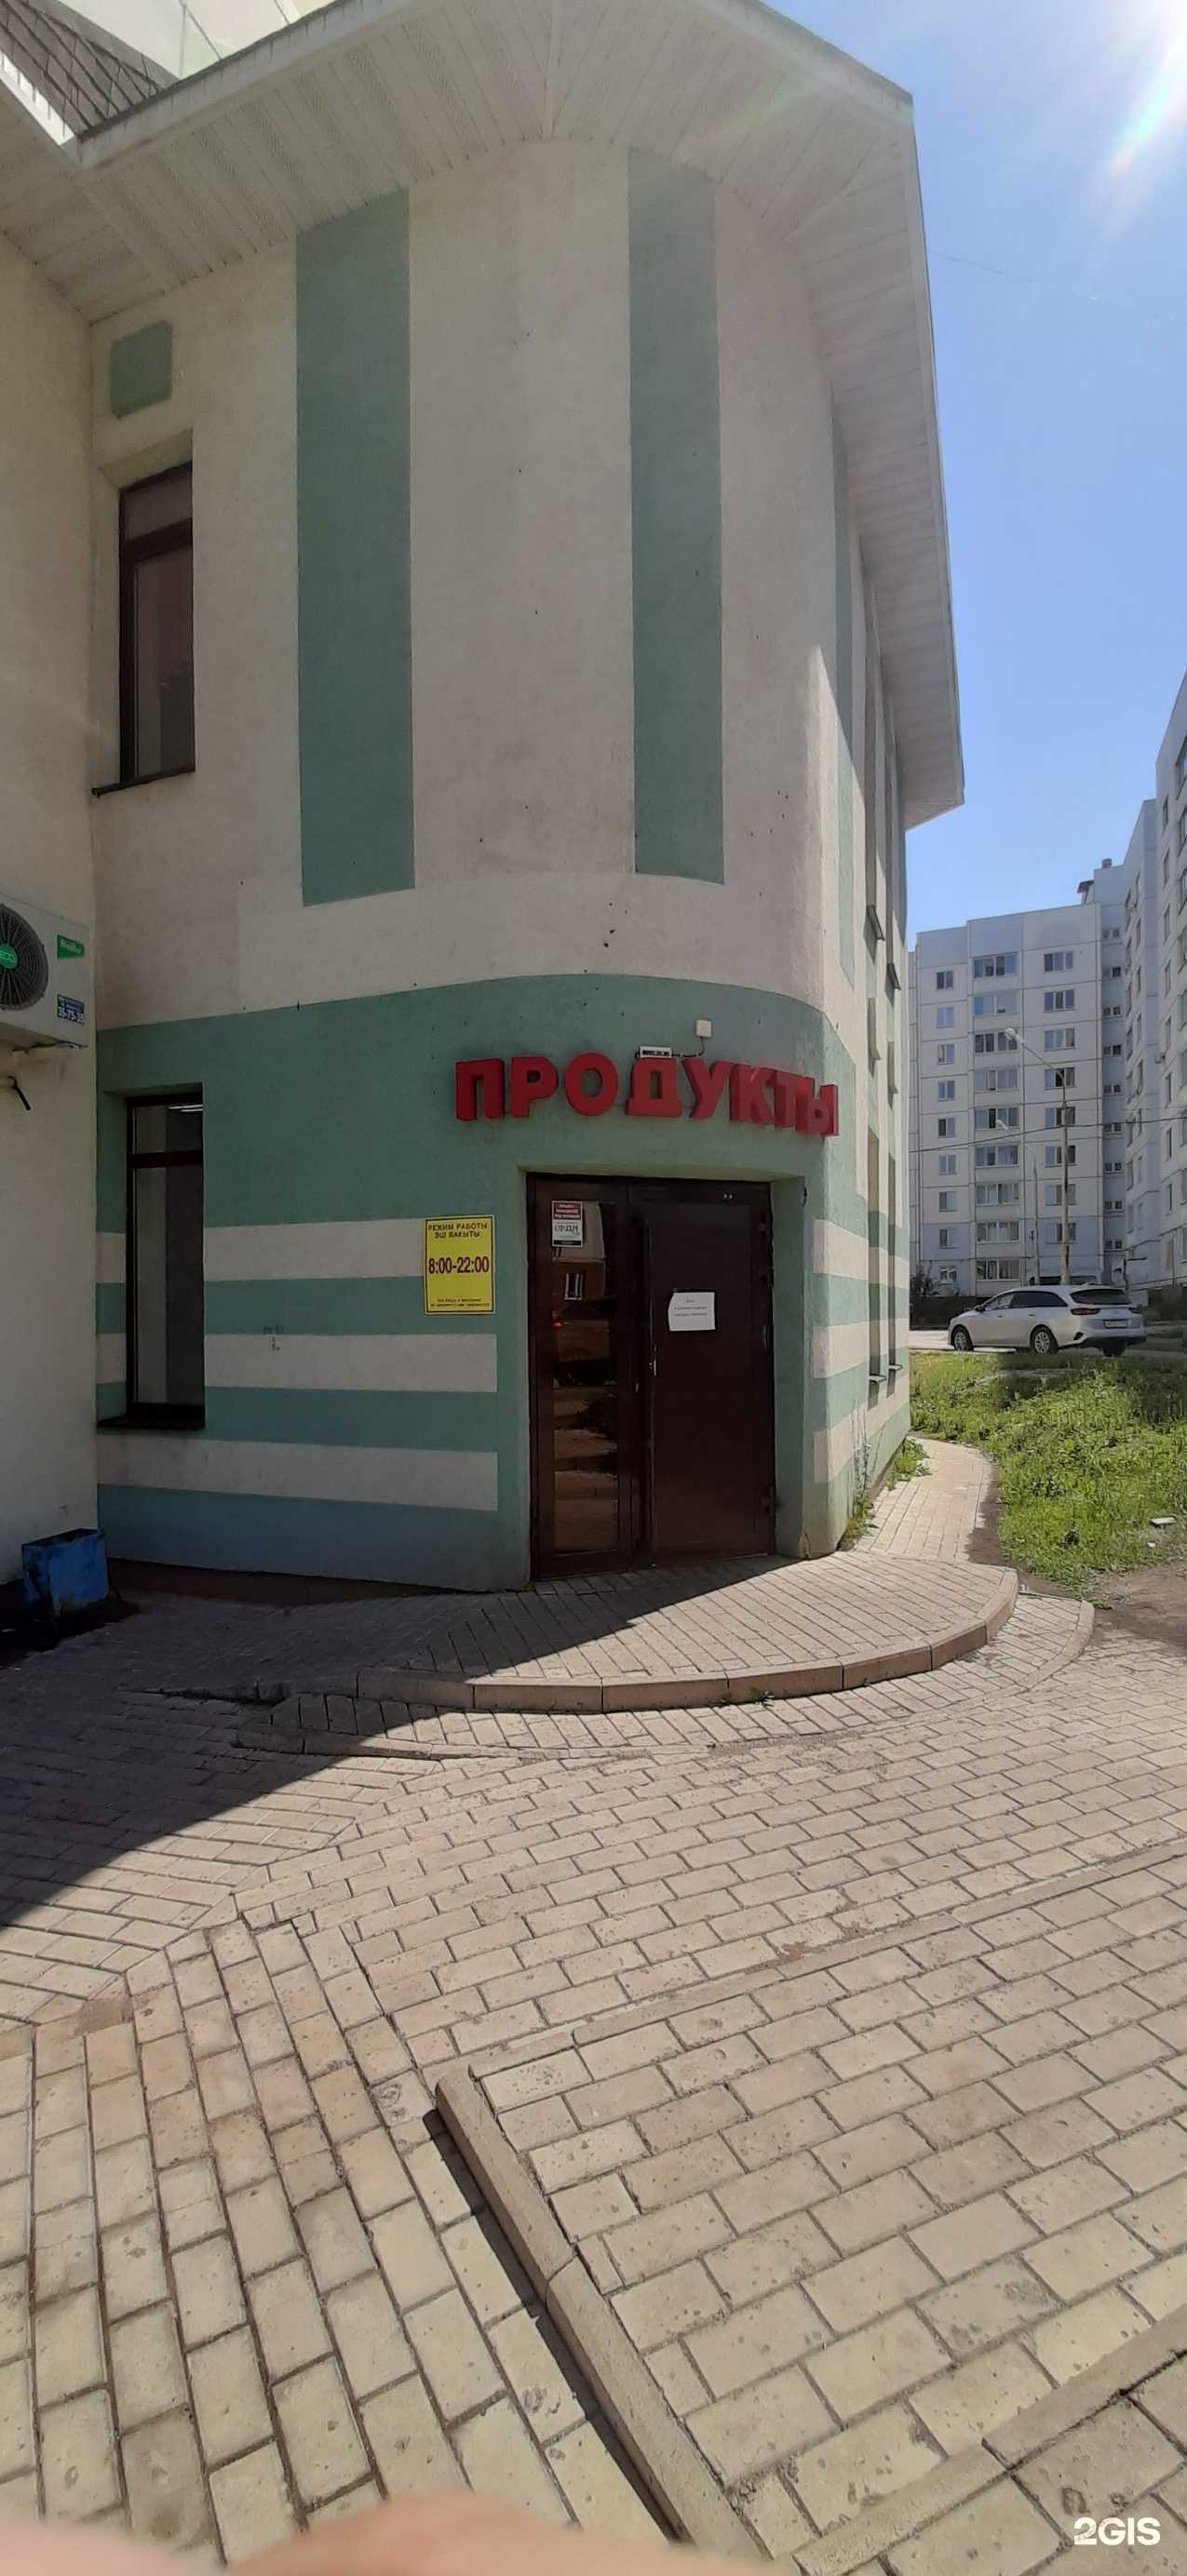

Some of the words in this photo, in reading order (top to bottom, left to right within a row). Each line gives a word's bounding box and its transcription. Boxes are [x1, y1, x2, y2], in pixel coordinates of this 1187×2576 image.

[455, 1053, 839, 1135] ПРОДУКТЫ
[456, 1222, 488, 1230] РАБОТЫ
[428, 1256, 489, 1274] 8:00-22:00
